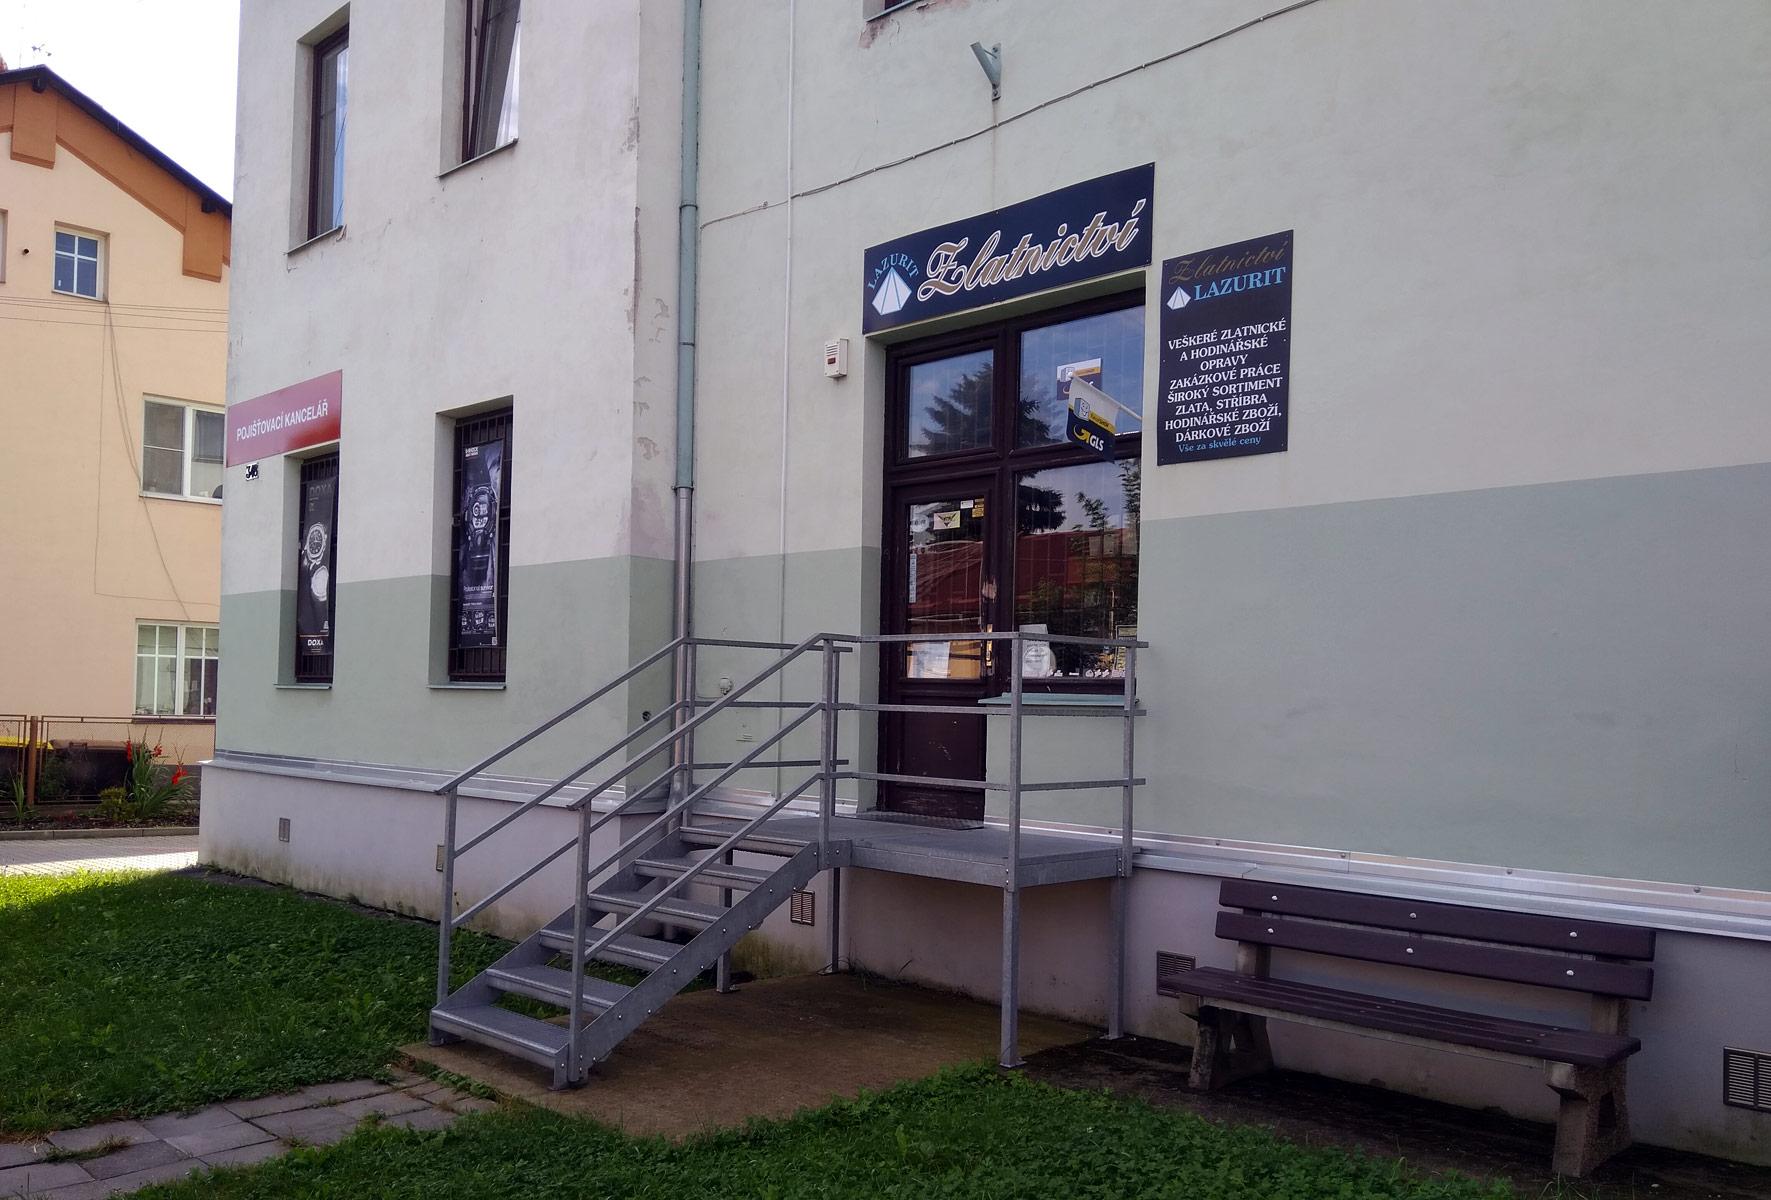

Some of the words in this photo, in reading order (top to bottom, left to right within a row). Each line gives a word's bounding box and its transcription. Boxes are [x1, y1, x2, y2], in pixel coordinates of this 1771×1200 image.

[917, 198, 1147, 302] Zlatnictví
[1168, 240, 1289, 285] Zlatnictví
[868, 253, 919, 290] LAZURIT
[1193, 266, 1287, 301] LAZURIT
[1168, 330, 1218, 350] VEŠKERÉ
[1220, 317, 1287, 340] ZLATNICKÉ
[1179, 352, 1188, 362] A
[1190, 334, 1269, 359] HODINÁŘSKÉ
[1200, 354, 1248, 371] OPRAVY
[1167, 386, 1210, 403] ŠIROKÝ
[1212, 377, 1283, 397] SORTIMENT
[1169, 369, 1237, 390] ZAKÁZKOVÉ
[1239, 363, 1281, 379] PRÁCE
[1165, 411, 1240, 430] HODINÁŘSKÉ
[1242, 403, 1282, 418] ZBOŽÍ,
[1175, 402, 1213, 416] ZLATA,
[1216, 393, 1268, 410] STŘÍBRA
[236, 411, 284, 441] POJIŠŤOVACÍ
[284, 398, 328, 428] KANCELÁŘ
[1175, 425, 1231, 443] DÁRKOVÉ
[1234, 418, 1271, 435] ZBOŽÍ
[1089, 435, 1105, 451] GLS
[1178, 443, 1194, 453] Vše
[1196, 443, 1206, 451] za
[1208, 438, 1237, 448] skvělé
[1239, 436, 1261, 445] ceny
